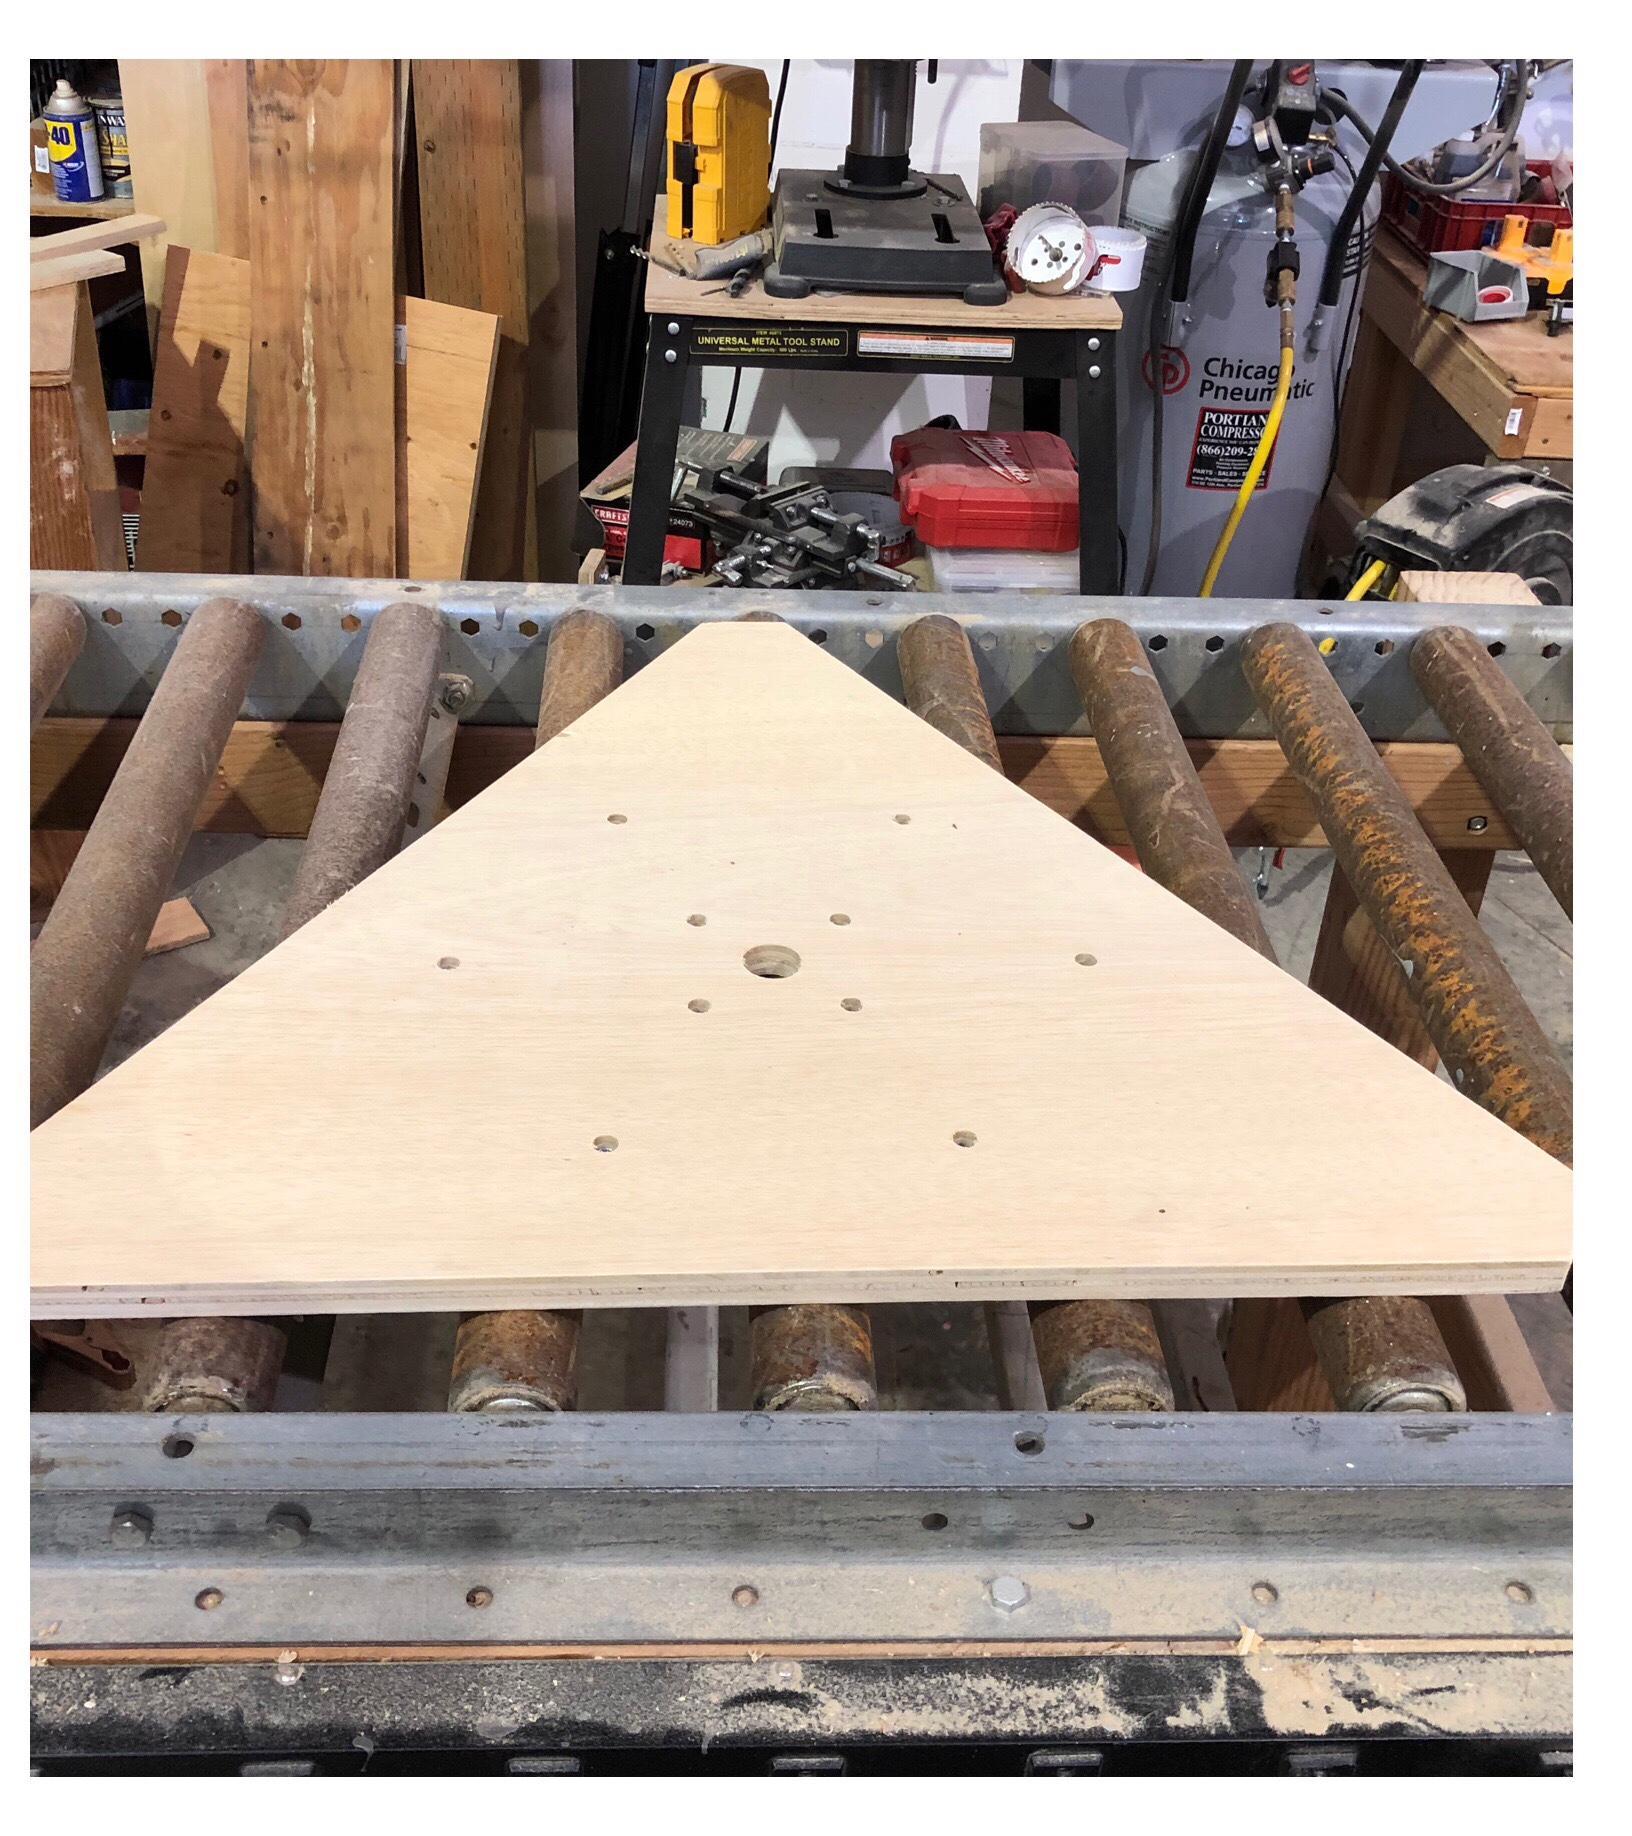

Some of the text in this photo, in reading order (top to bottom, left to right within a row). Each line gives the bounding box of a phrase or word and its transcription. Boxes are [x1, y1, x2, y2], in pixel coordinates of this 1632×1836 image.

[698, 336, 840, 346] UNIVERSAL METAL TOOL STAND
[1199, 379, 1315, 402] Pneumtic
[1204, 412, 1268, 427] PORTLAN
[594, 508, 629, 521] CRAFTS
